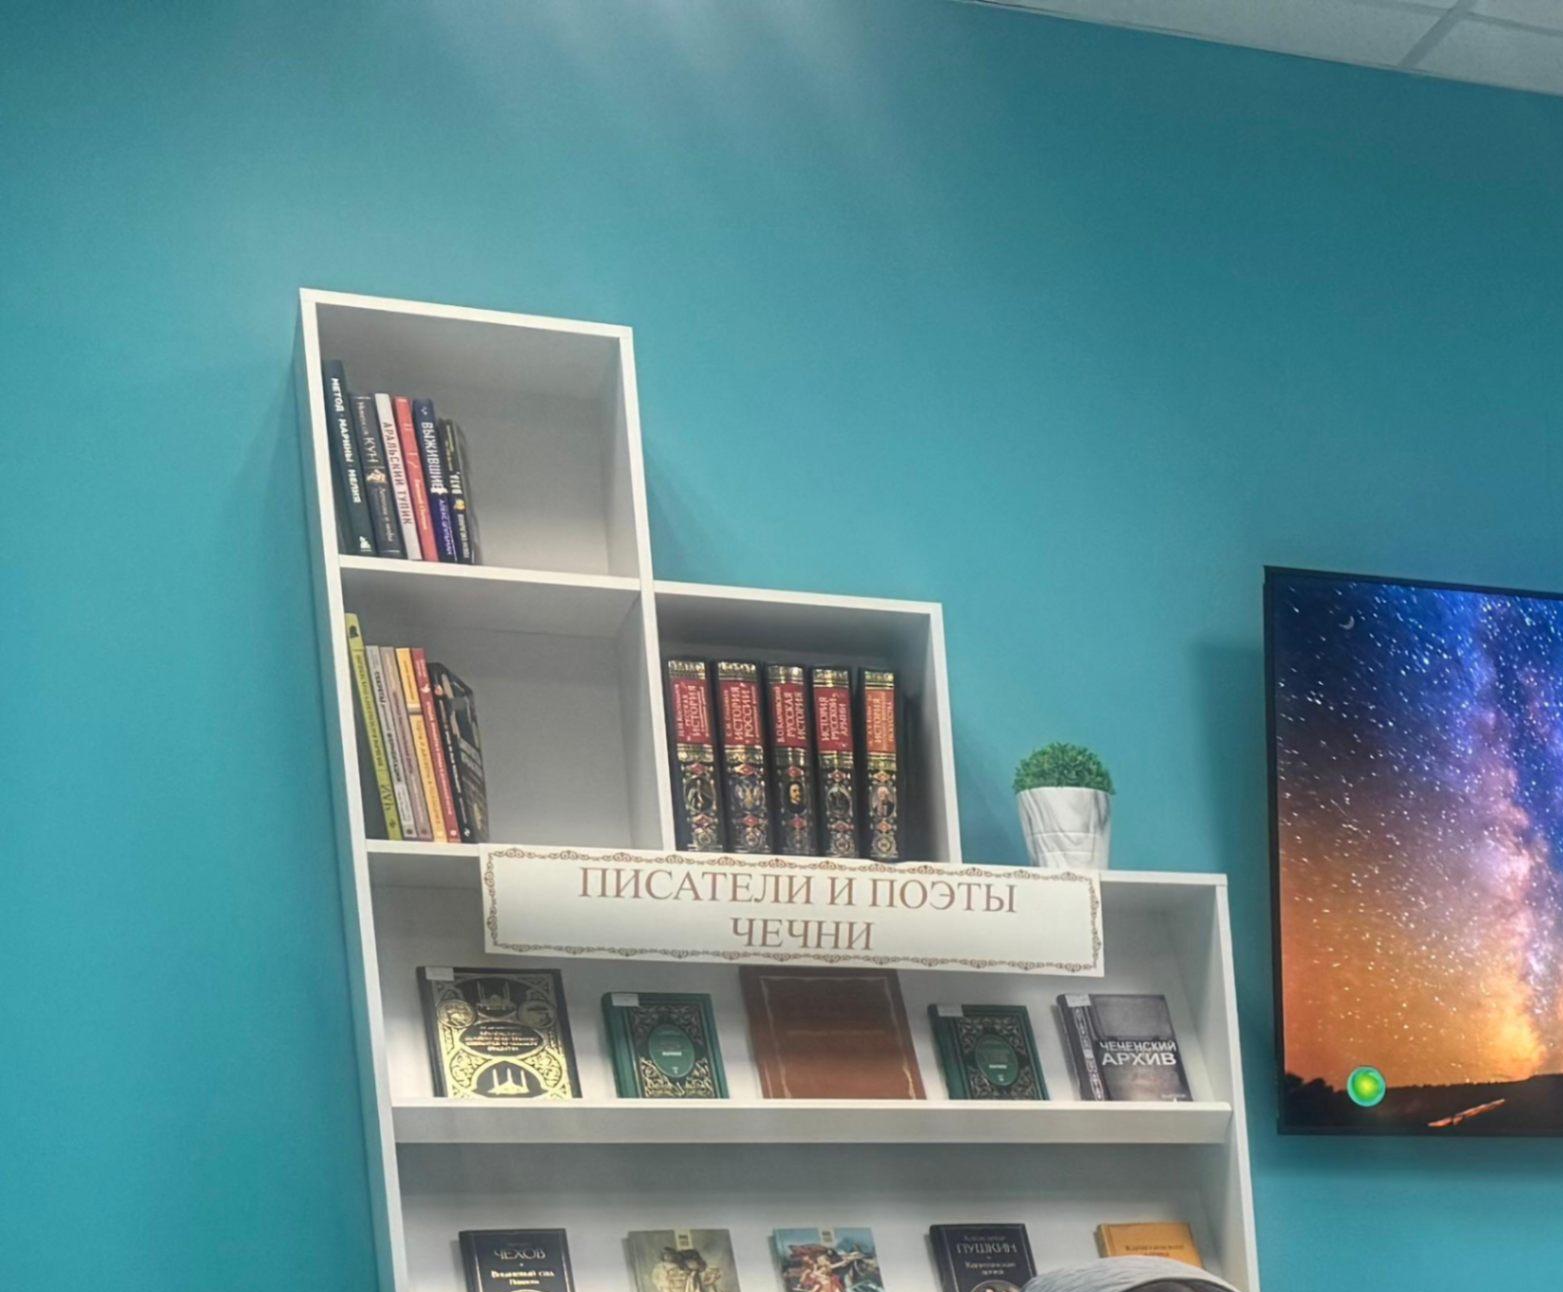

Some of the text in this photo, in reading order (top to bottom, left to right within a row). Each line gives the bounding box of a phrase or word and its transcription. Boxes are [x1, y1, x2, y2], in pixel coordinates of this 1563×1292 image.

[331, 377, 345, 413] МЕТОД
[339, 417, 354, 463] МАРИНЫ
[364, 436, 379, 464] КУН
[383, 421, 413, 525] АРАЛЬСКИЙ ТУПИК
[421, 421, 444, 492] ВЫЖИВШИЕ
[687, 685, 702, 737] ИСТОРИЯ
[730, 686, 744, 740] ИСТОРИЯ
[741, 689, 755, 738] РОССИИ
[784, 691, 797, 738] РУССКАЯ
[794, 691, 807, 740] ИСТОРИЯ
[818, 696, 830, 742] ИСТОРИЯ
[829, 697, 841, 741] РУССКОЙ
[578, 866, 1019, 914] ПИСАТЕЛИ И ПОЭТЫ
[730, 917, 876, 951] ЧЕЧНИ
[1100, 1039, 1177, 1053] ЧЕЧЕНСКИЙ
[1102, 1052, 1177, 1066] АРХИВ
[494, 1248, 546, 1260] ЧЕХОВ
[957, 1242, 1017, 1254] ПУШКИН
